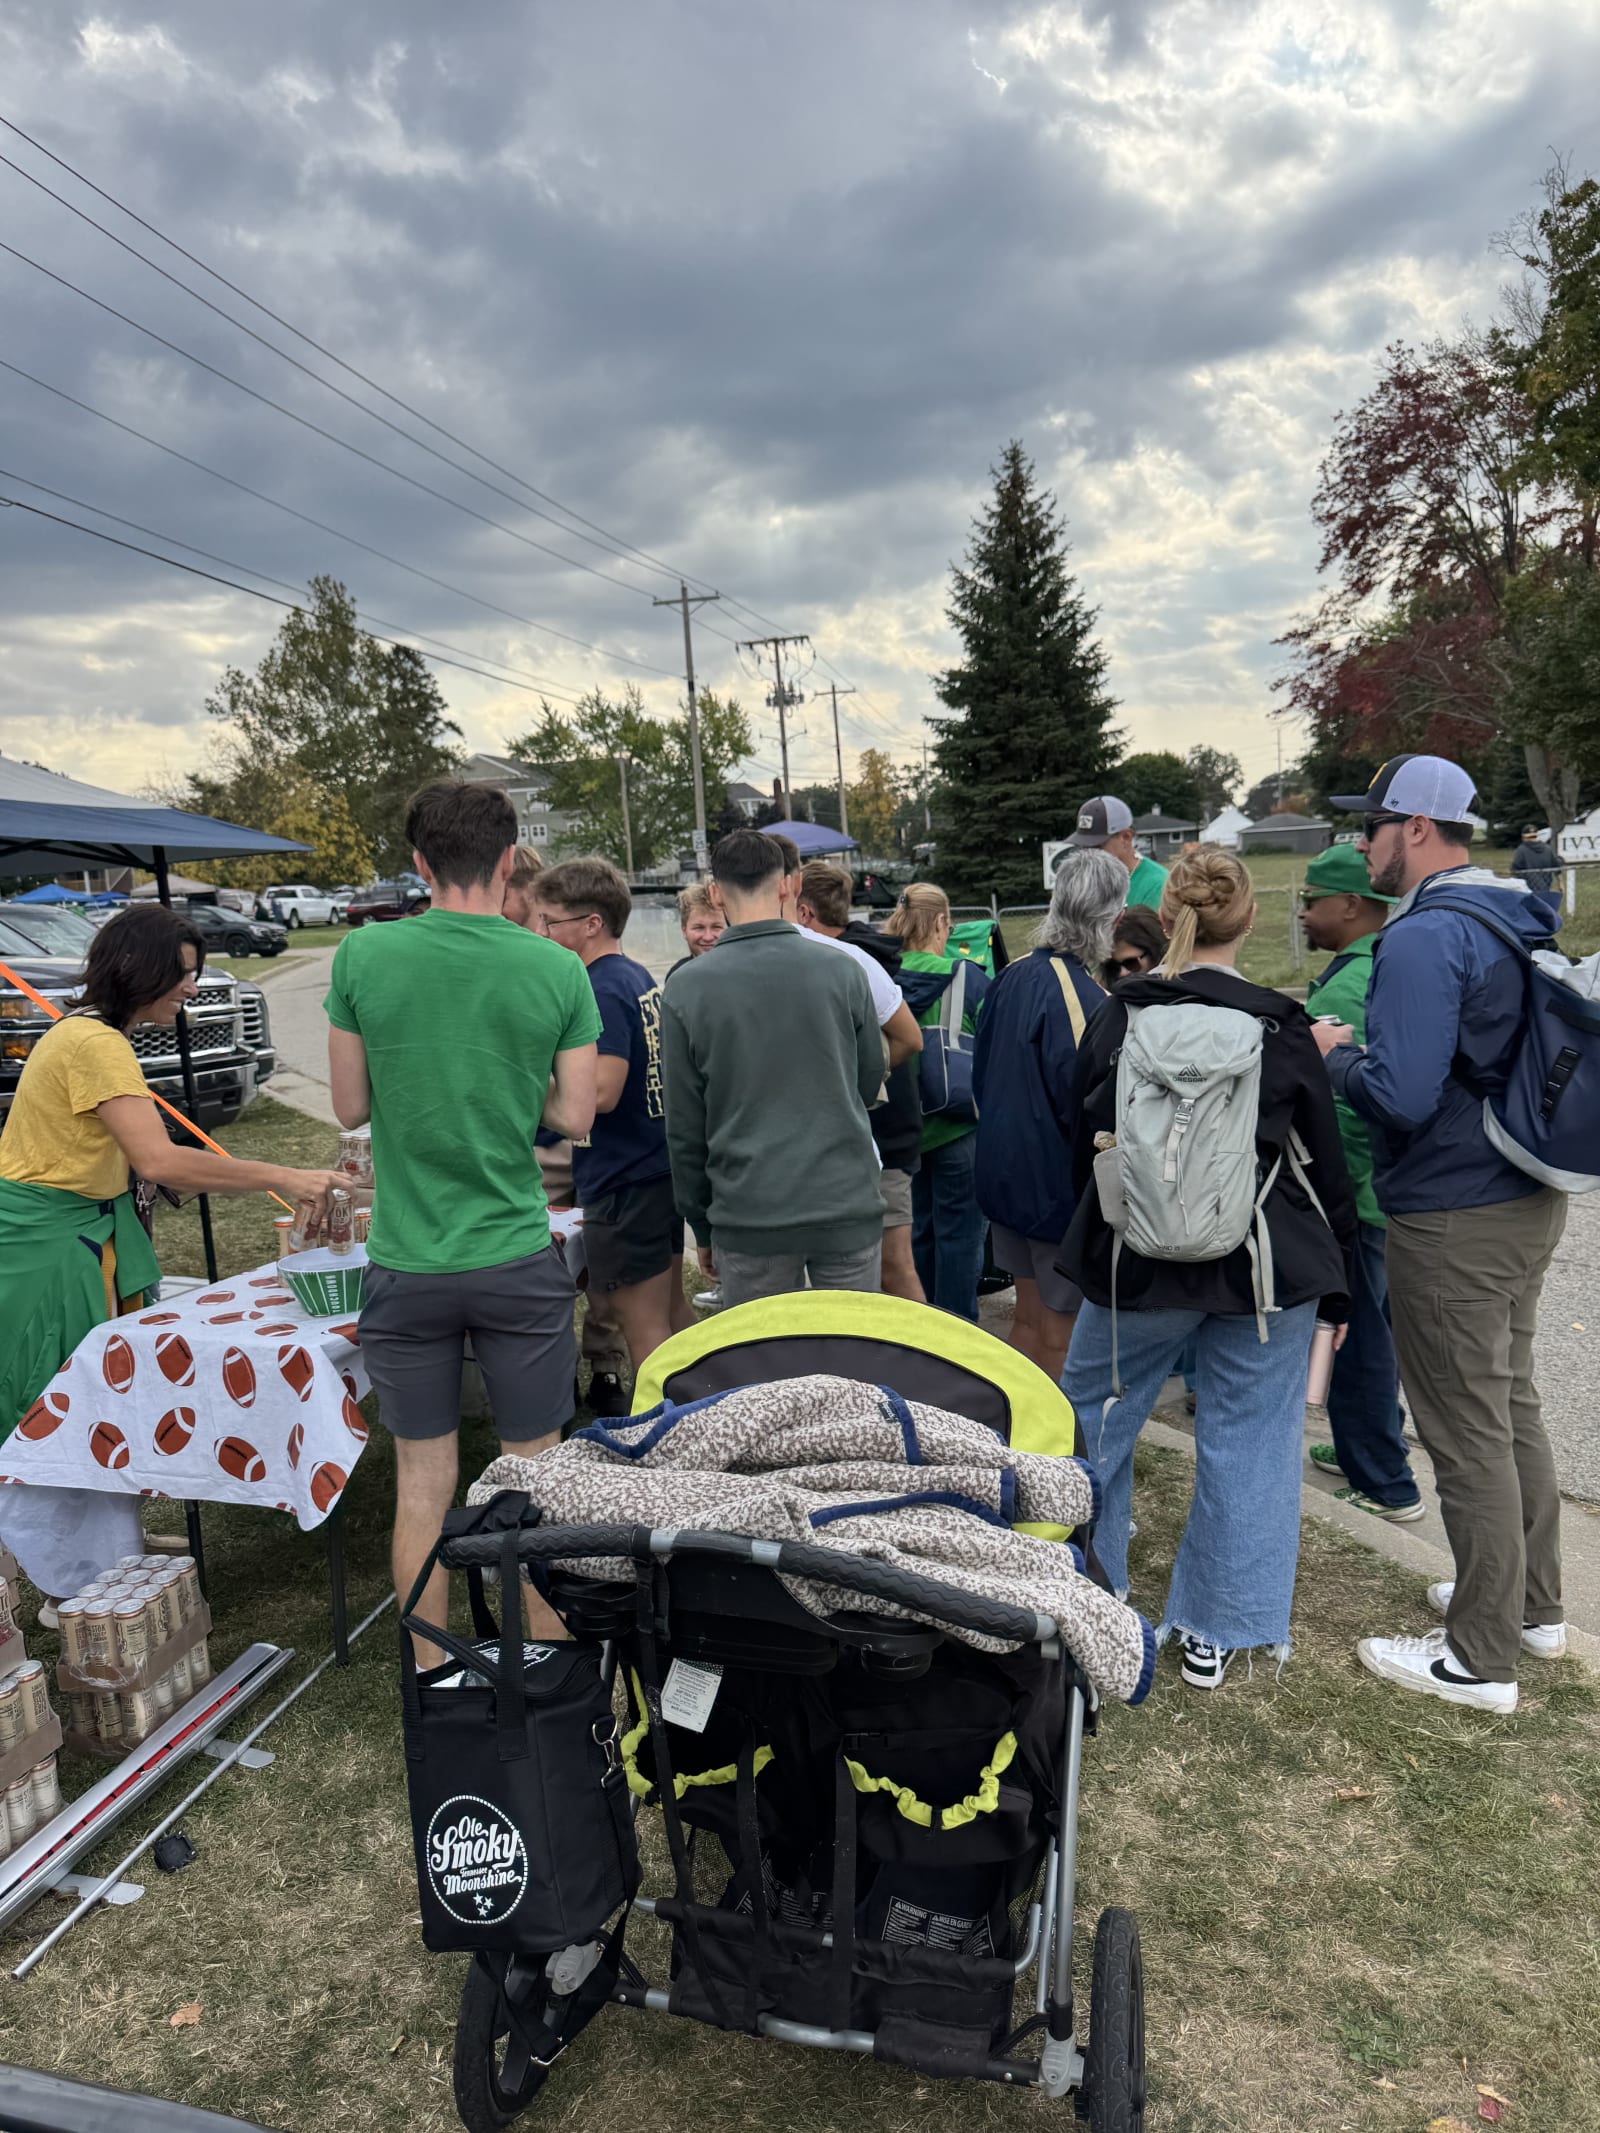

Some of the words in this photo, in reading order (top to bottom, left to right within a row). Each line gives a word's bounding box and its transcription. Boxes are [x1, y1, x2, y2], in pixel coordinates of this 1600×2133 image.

[325, 1275, 341, 1313] TOUCHDOWN
[458, 1815, 489, 1840] Ole
[430, 1823, 520, 1872] Smoky
[442, 1868, 522, 1896] Moonshine
[459, 1866, 488, 1878] Tennessee
[901, 1903, 927, 1919] WARNING
